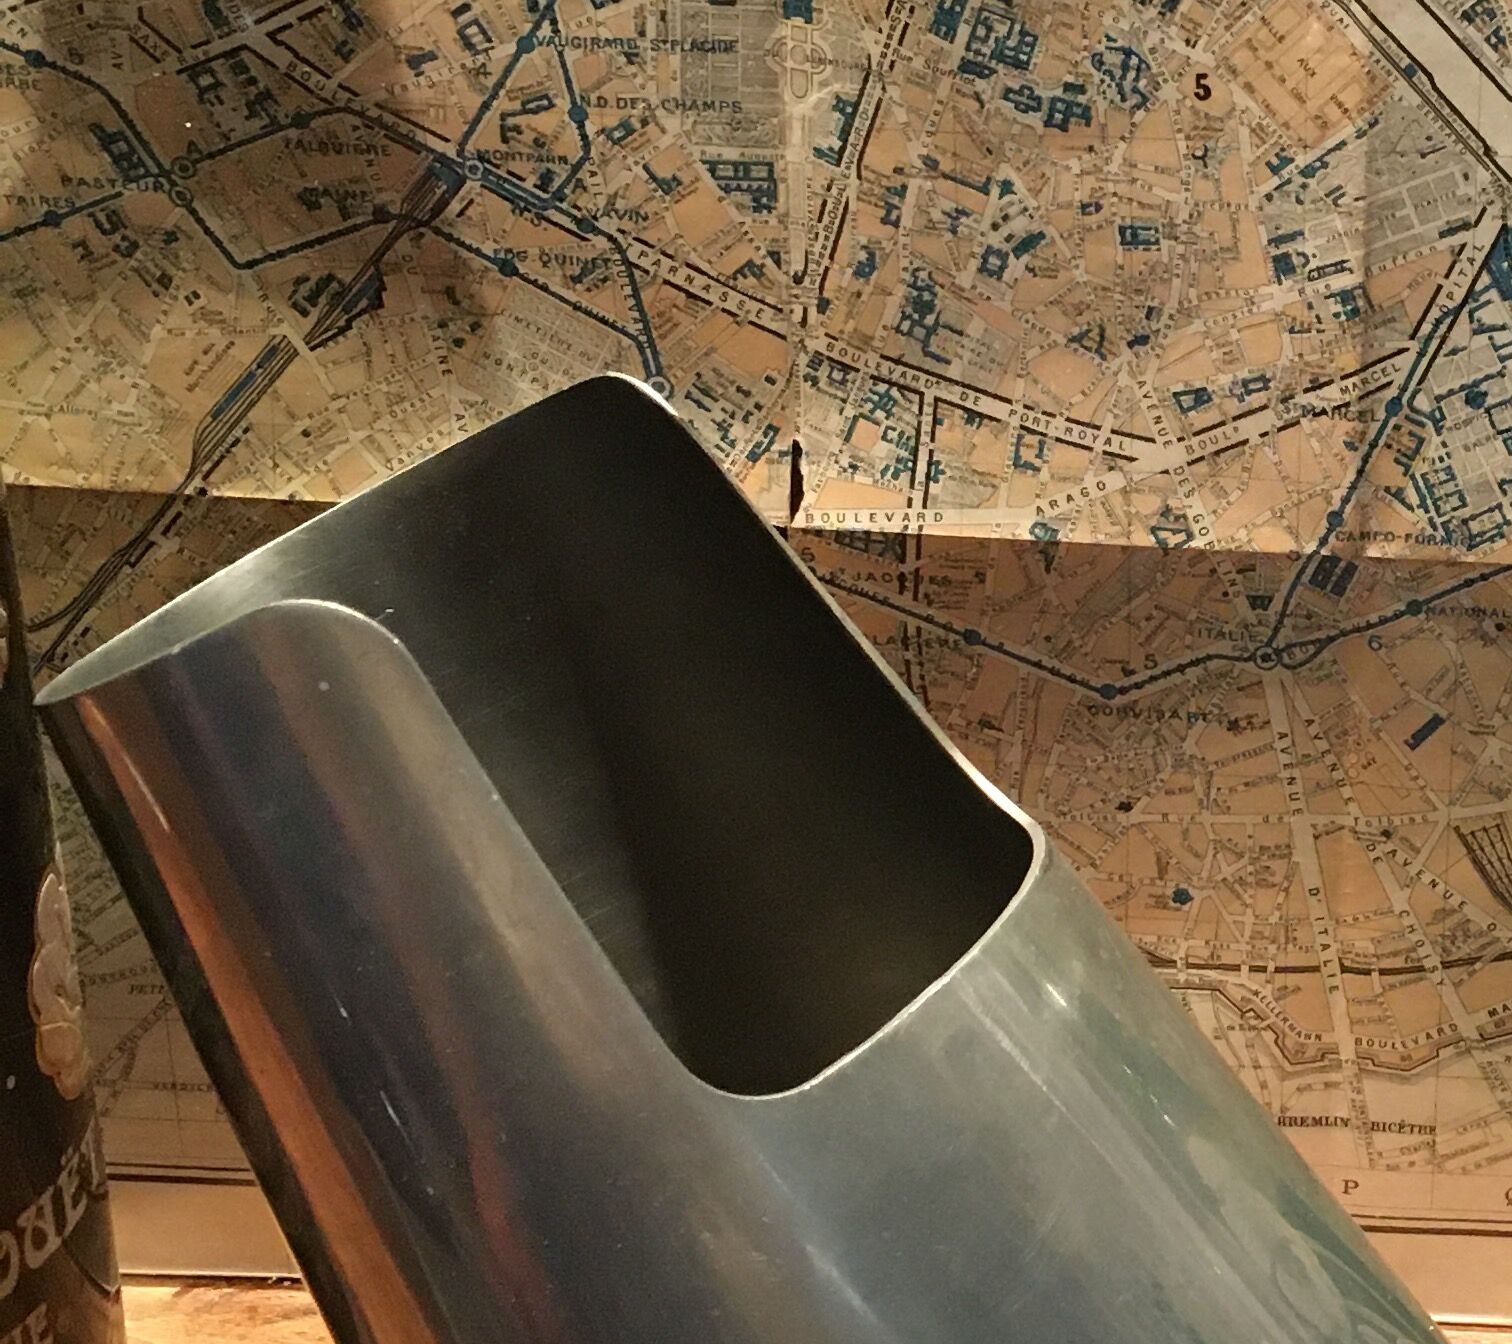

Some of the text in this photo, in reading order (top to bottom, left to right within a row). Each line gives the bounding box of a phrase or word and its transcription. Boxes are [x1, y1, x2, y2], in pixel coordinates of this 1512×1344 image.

[672, 37, 740, 55] PLACIDE
[1193, 71, 1212, 101] 5
[659, 97, 744, 115] CHAMPS
[636, 249, 768, 323] PARNASSE
[1339, 364, 1402, 398] MARCEL
[958, 391, 982, 408] DE
[1134, 377, 1175, 450] AVENUE
[1301, 402, 1382, 422] MARCEL
[804, 478, 1109, 525] BOULEVARD ARAGO
[1197, 627, 1260, 643] ITALIE
[1086, 703, 1213, 724] CORVISART
[1276, 729, 1304, 818] AVENUE
[1303, 715, 1446, 989] AVENUE DE CHOISY
[1386, 846, 1470, 913] AVENUE
[1251, 987, 1325, 1044] KELLERMANN
[1352, 1020, 1460, 1051] BOULEVARD
[1341, 1178, 1360, 1197] P
